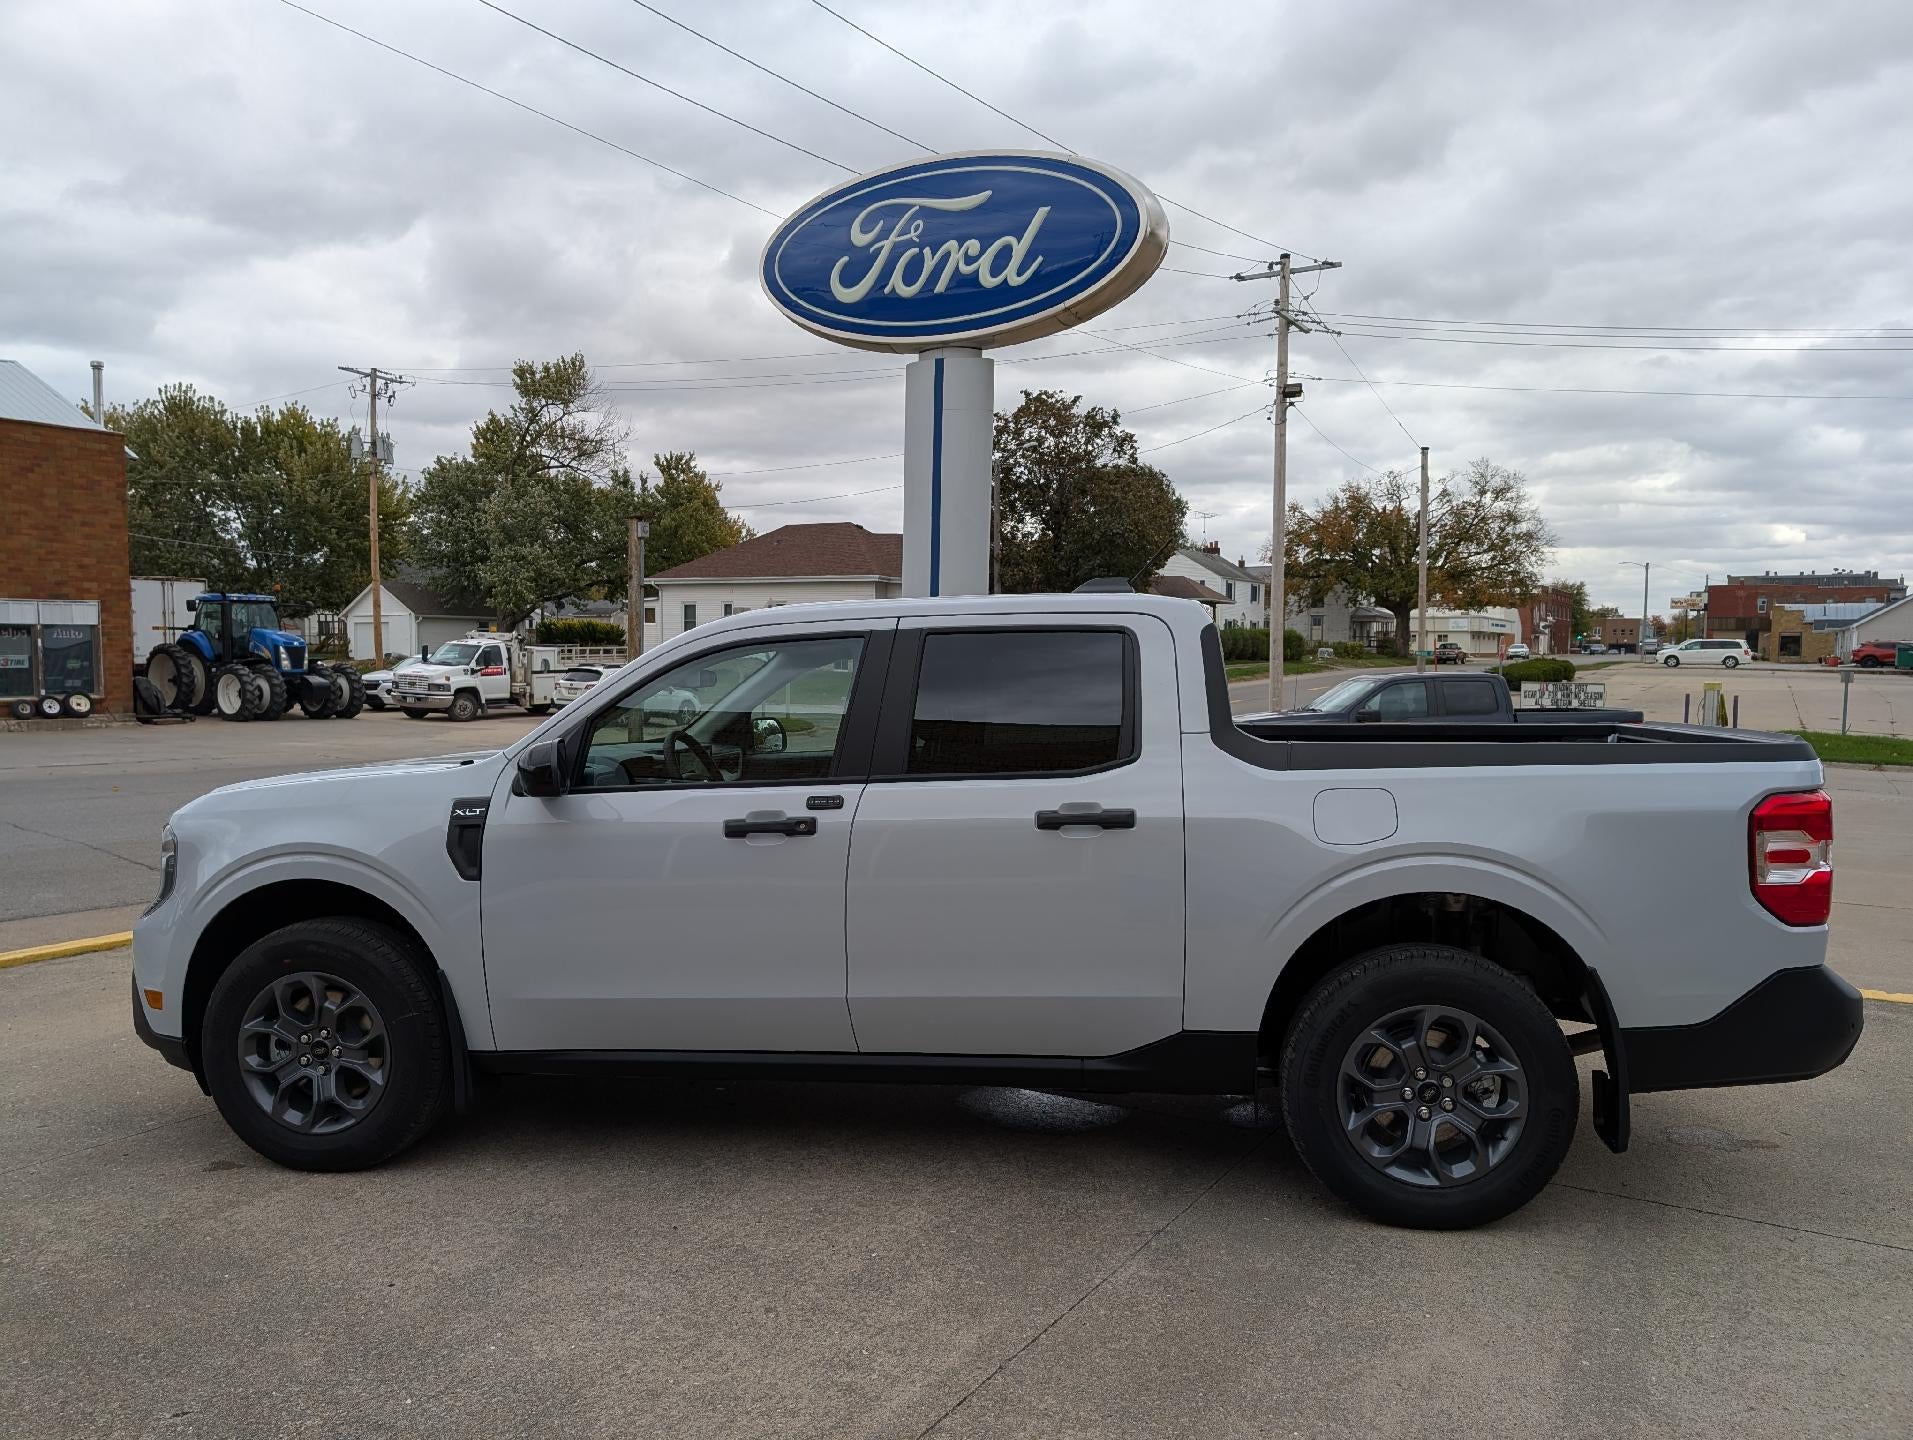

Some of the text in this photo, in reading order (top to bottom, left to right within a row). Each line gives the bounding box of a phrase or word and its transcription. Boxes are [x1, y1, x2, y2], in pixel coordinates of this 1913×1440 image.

[830, 189, 1051, 304] Ford
[53, 628, 83, 639] Auto
[1552, 683, 1573, 692] TRADING
[1575, 684, 1589, 693] POST
[1524, 690, 1537, 699] GEAR
[1539, 690, 1546, 699] UP
[1548, 691, 1559, 699] FOR
[1584, 692, 1604, 700] SEASON
[1578, 699, 1597, 708] SHELLS
[453, 807, 486, 816] XLT
